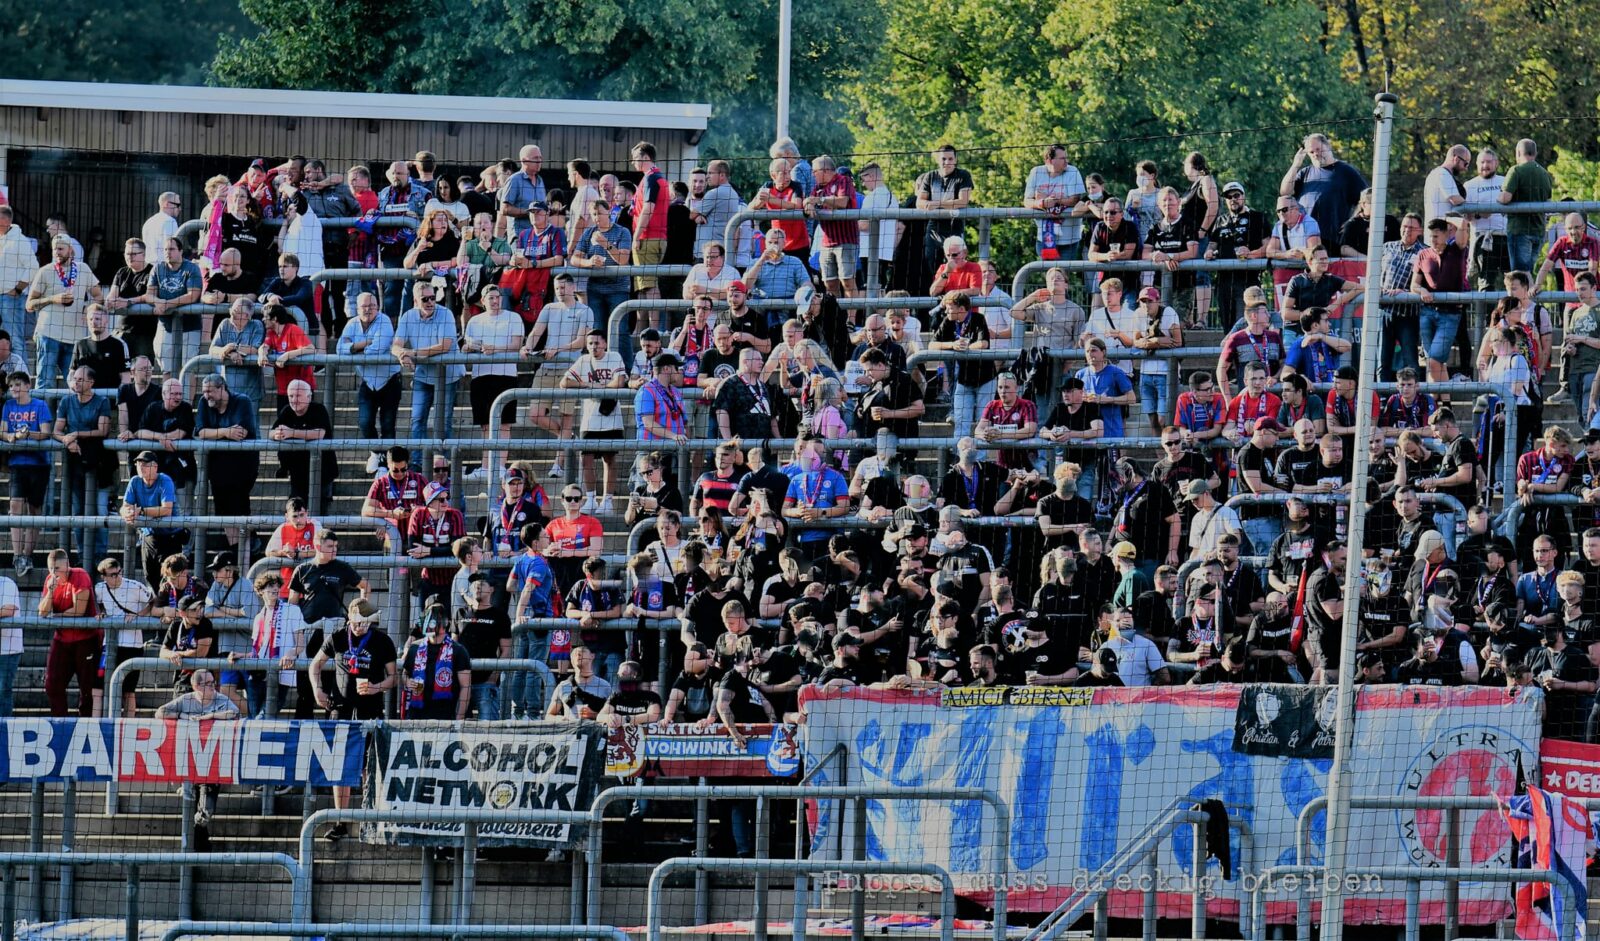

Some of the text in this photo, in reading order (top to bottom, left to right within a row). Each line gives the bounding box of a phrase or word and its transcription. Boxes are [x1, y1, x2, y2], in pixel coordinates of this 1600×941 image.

[587, 368, 612, 383] NKE
[9, 411, 37, 422] CORE
[7, 717, 351, 782] BARMEN
[390, 739, 579, 775] ALCOHOL
[386, 776, 579, 811] NETWORK
